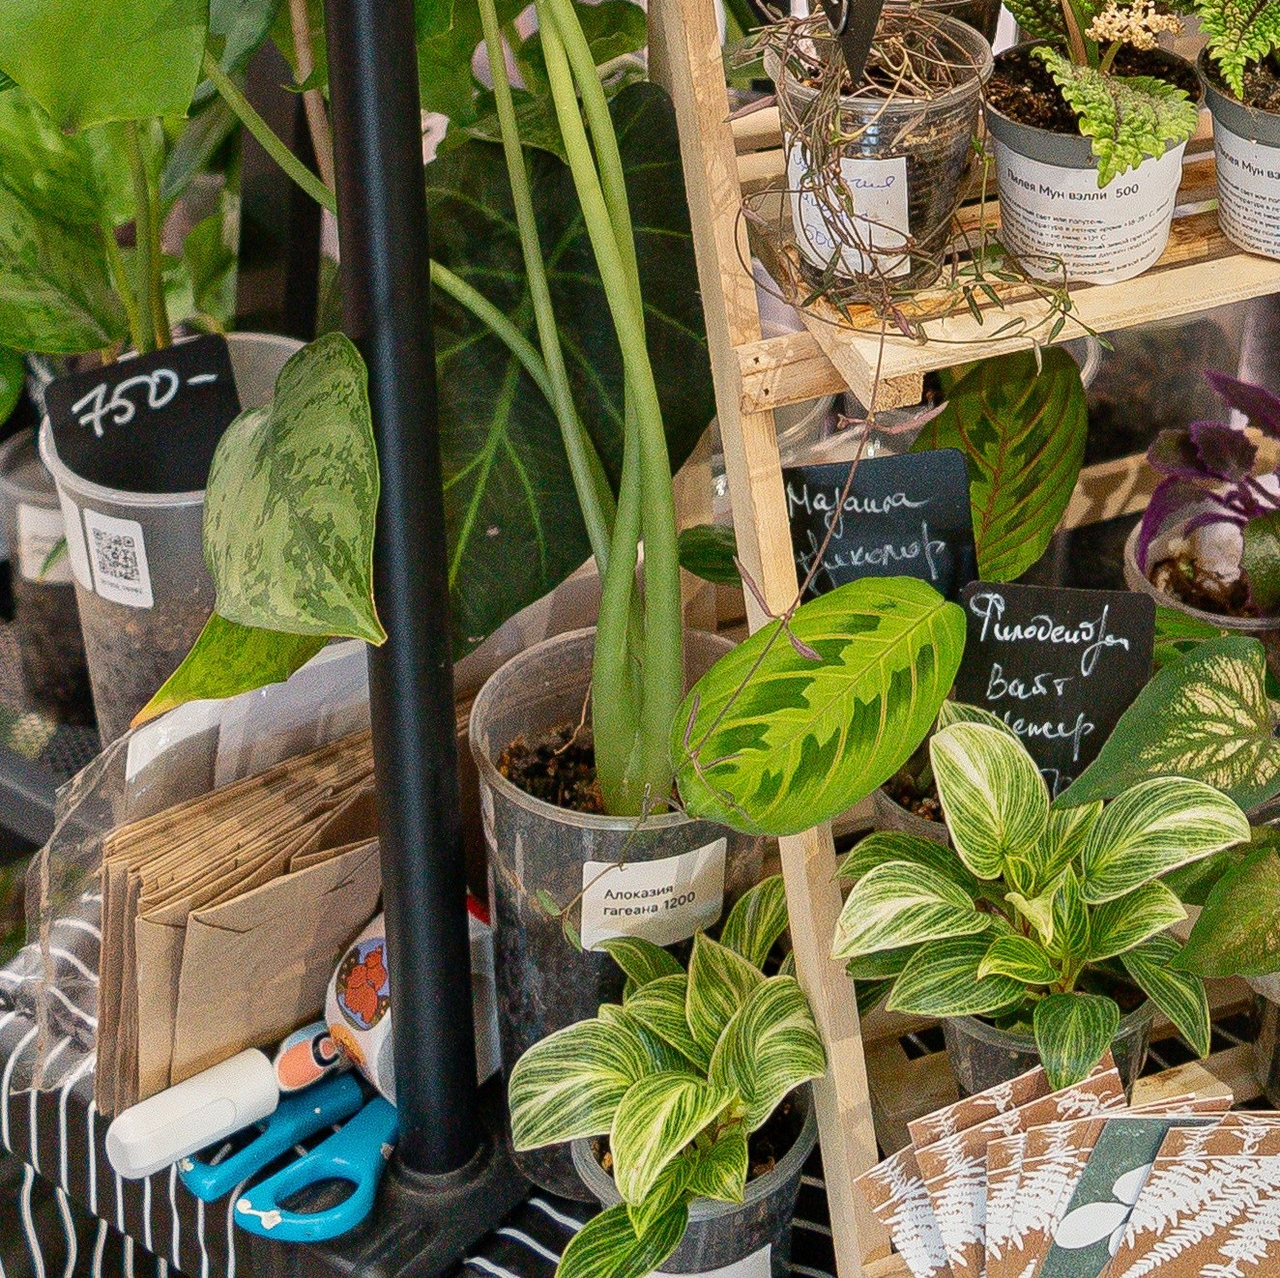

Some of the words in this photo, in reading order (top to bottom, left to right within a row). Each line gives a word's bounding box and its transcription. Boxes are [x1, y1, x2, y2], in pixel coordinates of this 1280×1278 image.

[1241, 160, 1265, 177] Мун
[1038, 185, 1065, 200] Мун
[1068, 191, 1108, 202] вэлли
[1115, 183, 1140, 199] 500
[71, 368, 219, 438] 750-
[603, 885, 674, 900] Алоказия
[602, 904, 659, 916] гагеана
[664, 891, 696, 910] 1200
